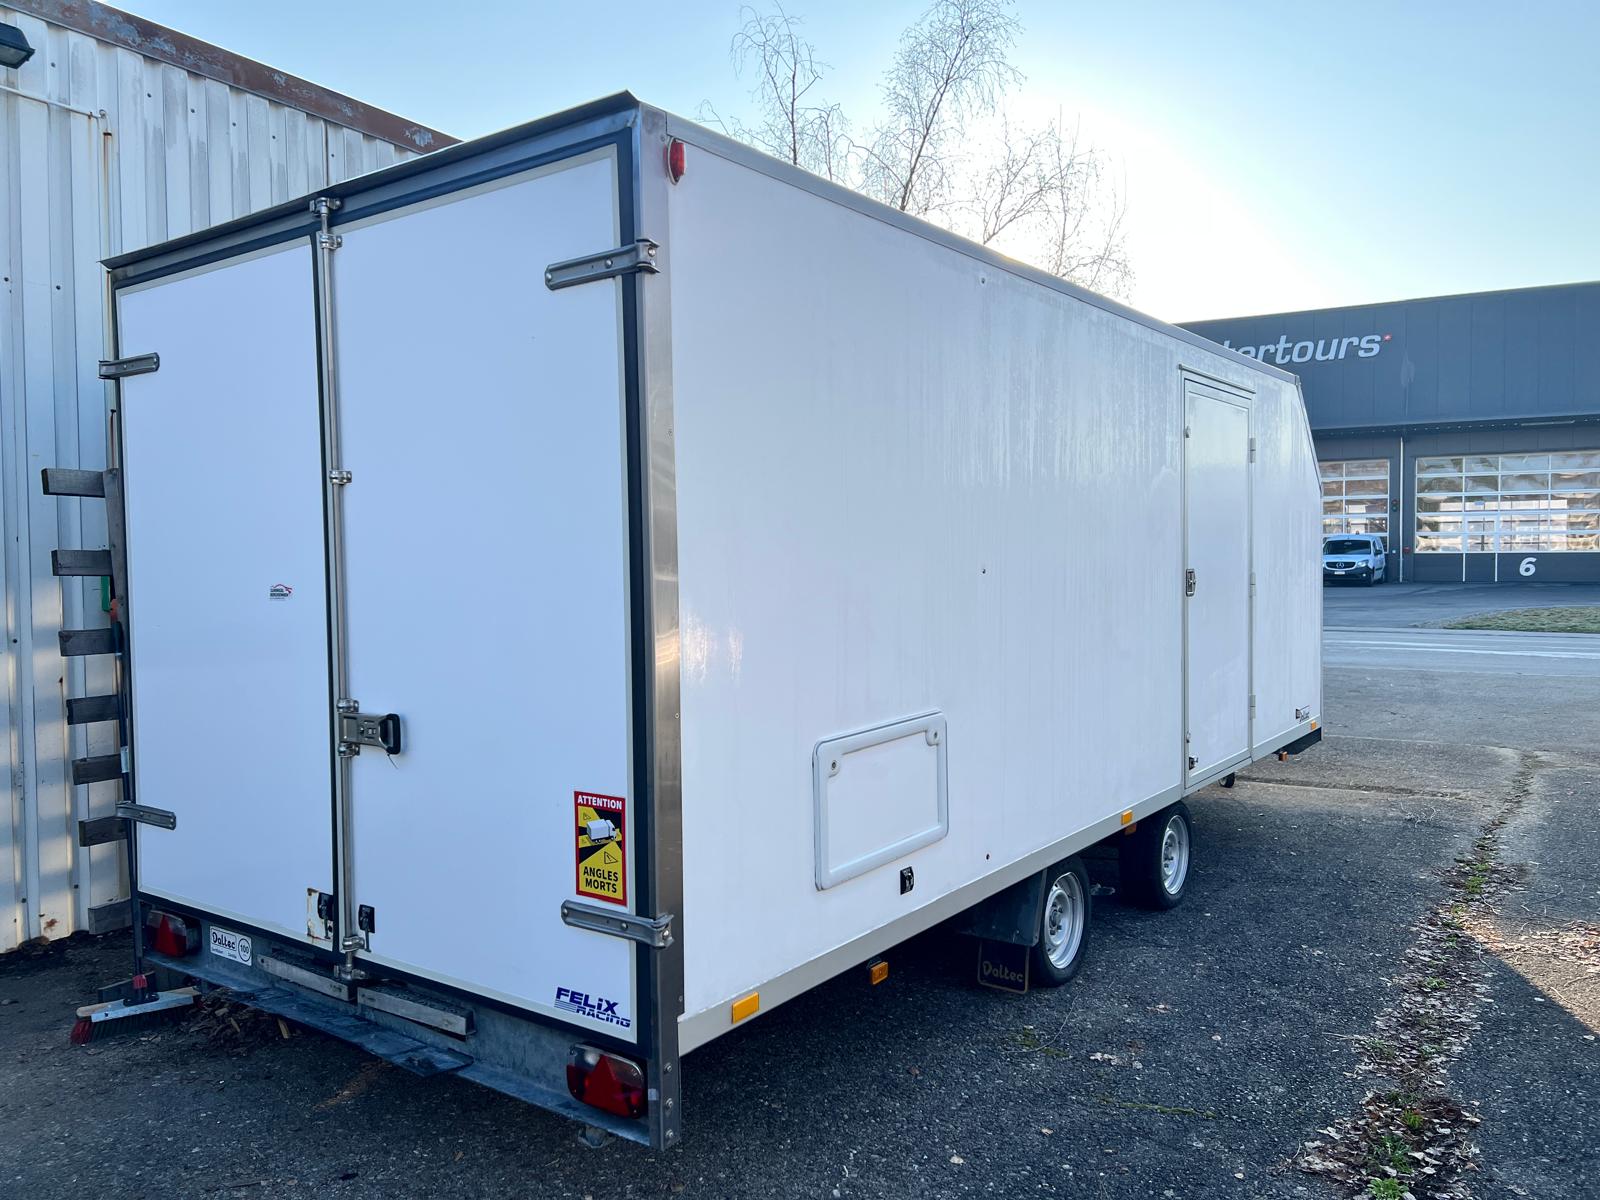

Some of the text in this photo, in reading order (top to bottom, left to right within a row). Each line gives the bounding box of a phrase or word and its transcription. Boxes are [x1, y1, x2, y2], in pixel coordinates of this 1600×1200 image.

[1519, 557, 1537, 577] 6
[577, 795, 622, 810] ATTENTION
[583, 866, 619, 882] ANGLES
[585, 878, 617, 893] MORTS
[212, 931, 236, 949] Daltec
[982, 960, 1024, 983] Daltec
